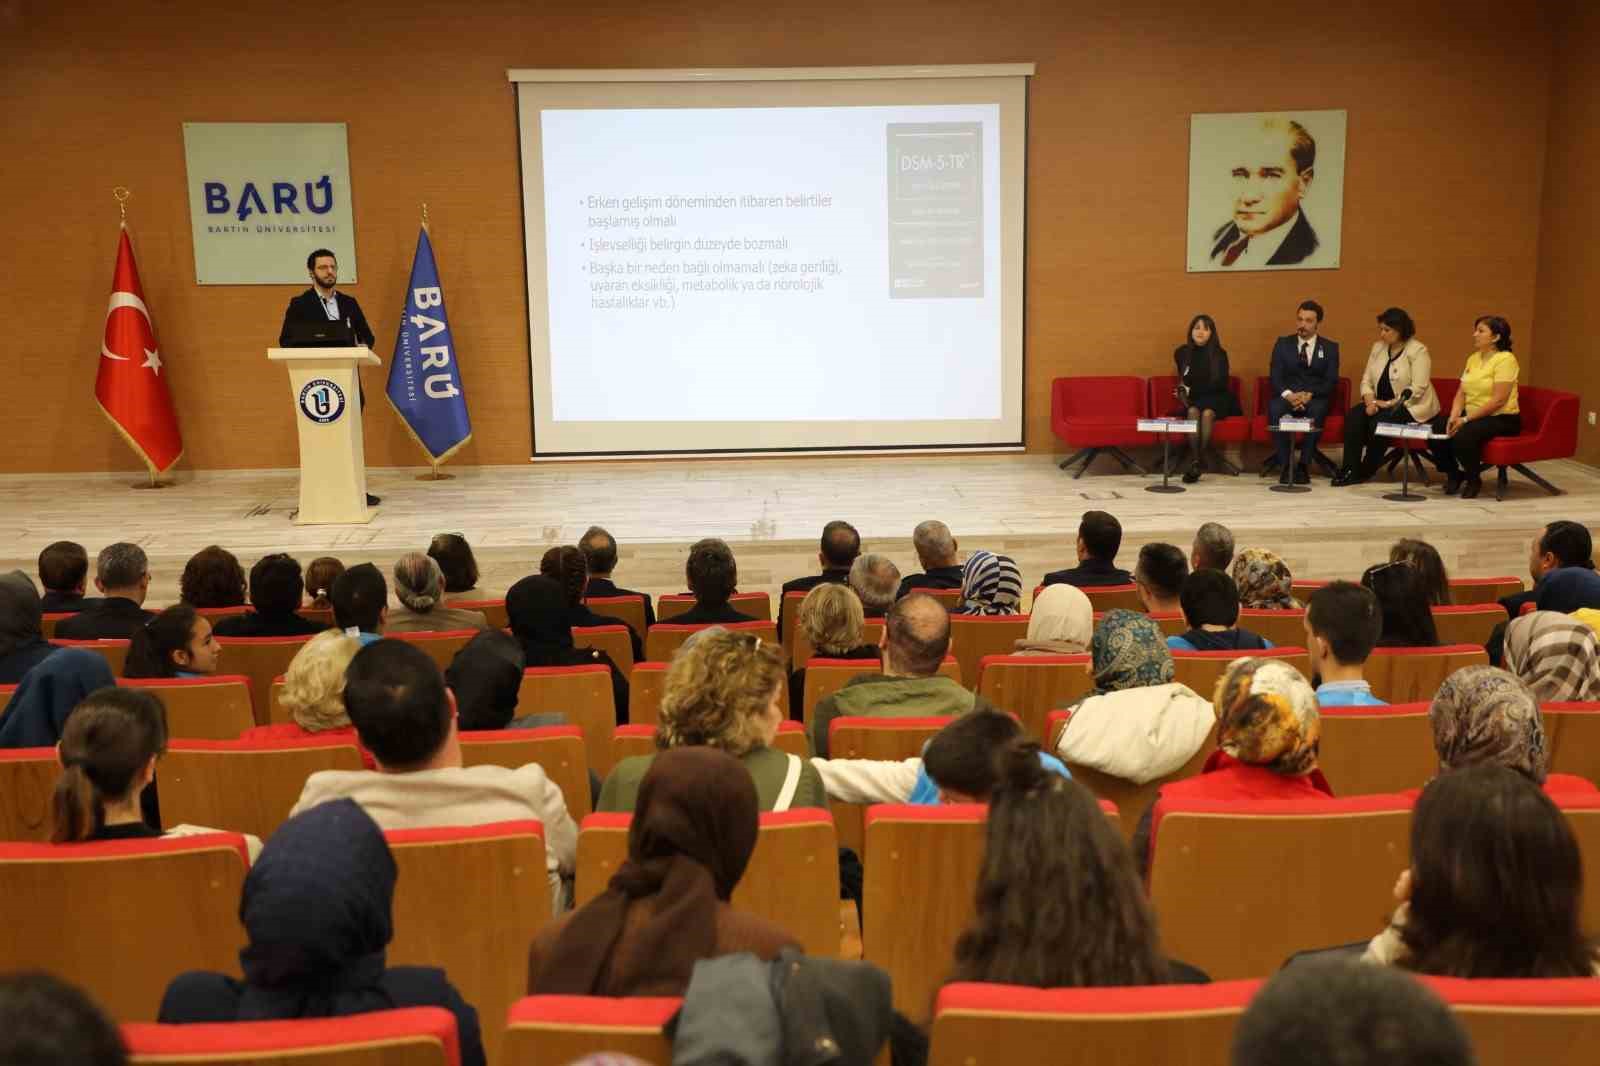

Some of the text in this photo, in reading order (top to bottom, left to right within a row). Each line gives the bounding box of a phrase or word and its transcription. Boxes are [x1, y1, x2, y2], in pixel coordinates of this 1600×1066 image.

[587, 196, 620, 209] Erken
[622, 195, 662, 212] gelişim
[664, 194, 736, 209] döneminden
[627, 261, 640, 274] bir
[741, 281, 755, 295] ya
[756, 278, 771, 291] da
